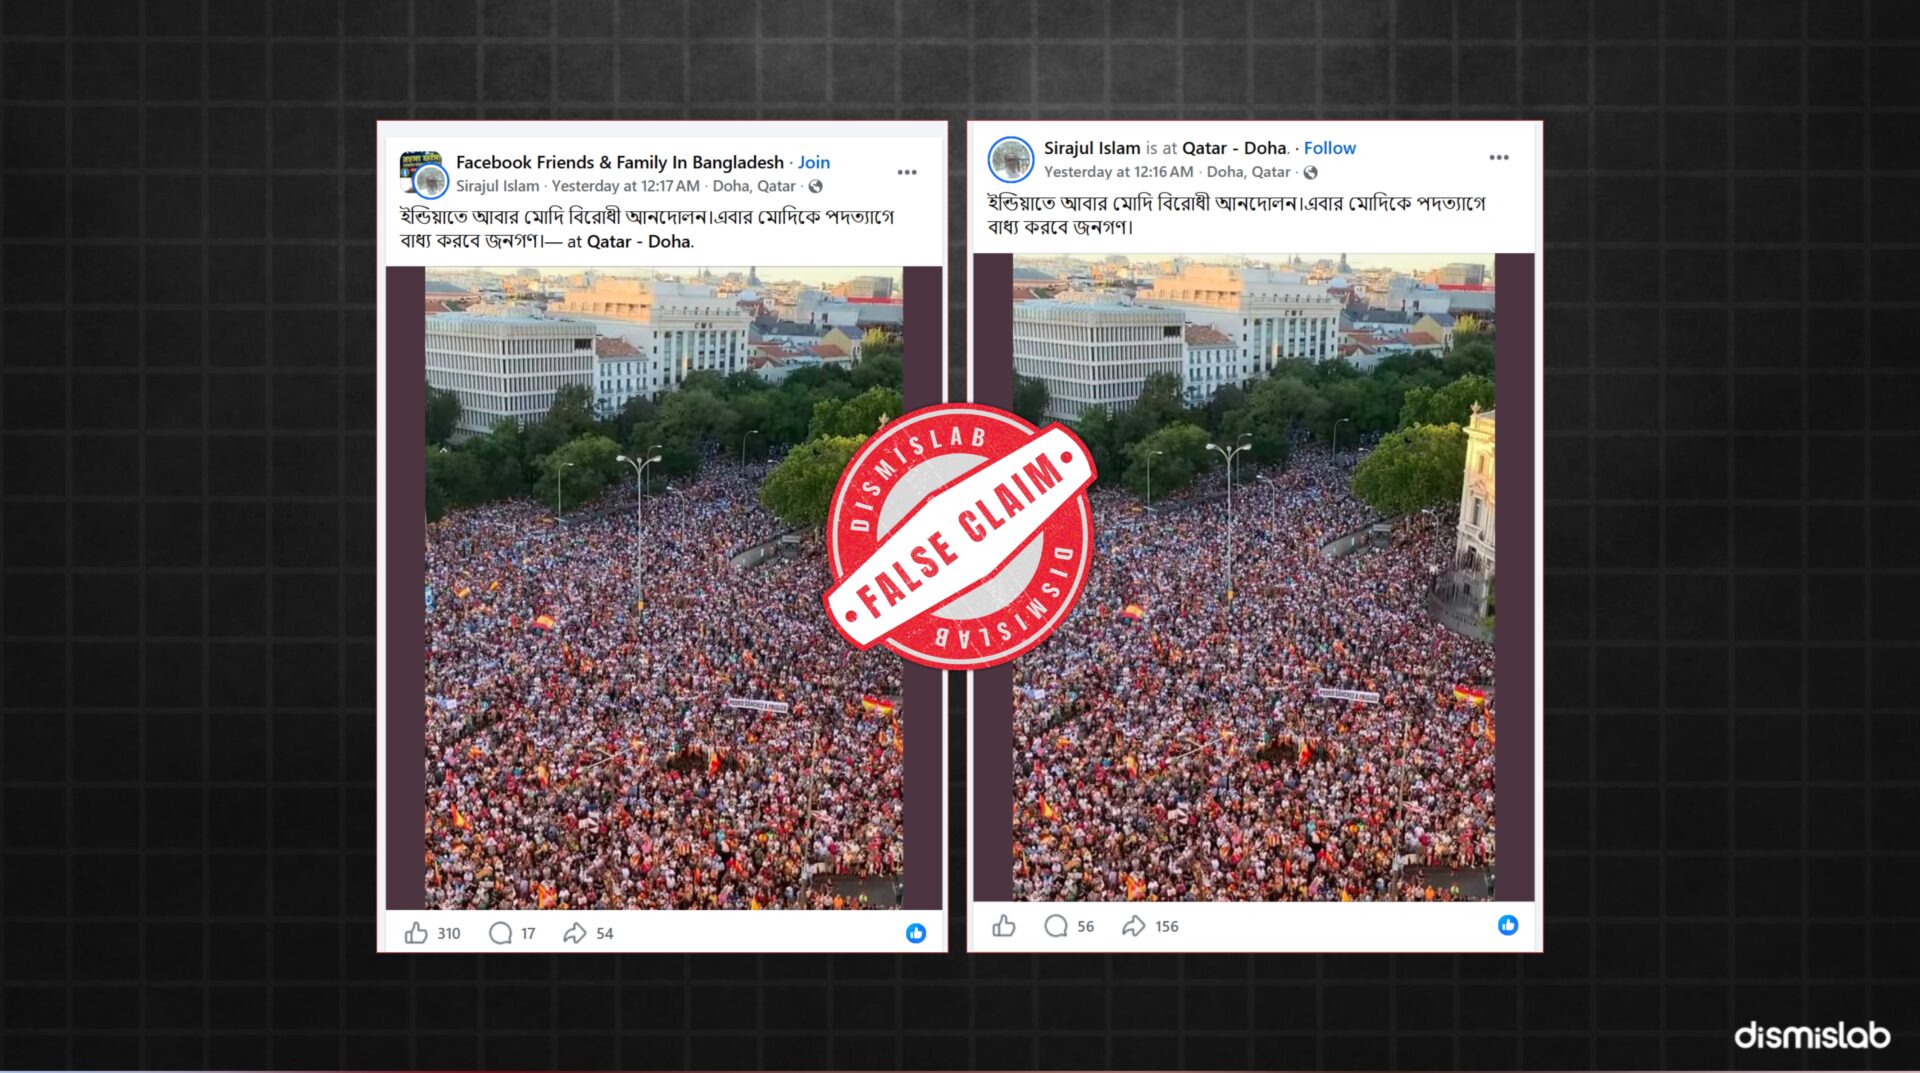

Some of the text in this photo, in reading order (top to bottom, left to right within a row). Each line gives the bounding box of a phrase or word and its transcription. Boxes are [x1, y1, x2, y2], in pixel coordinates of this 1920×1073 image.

[1045, 141, 1093, 158] Sirajul
[1100, 141, 1140, 155] Islam
[1147, 141, 1158, 155] is
[1163, 143, 1177, 155] at
[1183, 142, 1227, 156] Qatar
[1305, 141, 1356, 155] Follow
[457, 155, 532, 170] Facebook
[538, 155, 594, 170] Friends
[600, 156, 611, 170] &
[617, 155, 667, 173] Family
[673, 155, 687, 170] In
[693, 155, 784, 173] Bangladesh
[798, 155, 830, 170] Join
[1045, 165, 1112, 180] Yesterday
[1117, 166, 1130, 178] at
[1135, 166, 1167, 178] 12:16
[1208, 166, 1246, 180] Doha,
[1252, 166, 1290, 180] Qatar
[457, 179, 498, 195] Sirajul
[504, 179, 539, 192] Islam
[552, 179, 619, 195] Yesterday
[624, 180, 637, 192] at
[642, 180, 673, 192] 12:17
[714, 179, 752, 194] Doha,
[758, 180, 796, 194] Qatar
[987, 192, 1056, 211] ইন্ডিয়াতে
[1060, 196, 1108, 211] আবার
[1113, 192, 1153, 211] মোদি
[1158, 192, 1210, 211] বিরোধী
[1349, 192, 1411, 211] মোদিকে
[1417, 196, 1486, 211] পদত্যাগে
[400, 205, 468, 225] ইন্ডিয়াতে
[472, 210, 520, 225] আবার
[525, 205, 564, 225] মোদি
[568, 205, 621, 225] বিরোধী
[759, 205, 821, 225] মোদিকে
[826, 210, 894, 225] পদত্যাগে
[987, 220, 1020, 236] বাধ্য
[1024, 221, 1069, 236] করবে
[400, 234, 432, 249] বাধ্য
[436, 235, 480, 249] করবে
[568, 235, 582, 249] at
[587, 235, 632, 249] Qatar
[649, 234, 694, 249] Doha.
[437, 928, 613, 940] 310 17 54
[1078, 921, 1179, 933] 56 156
